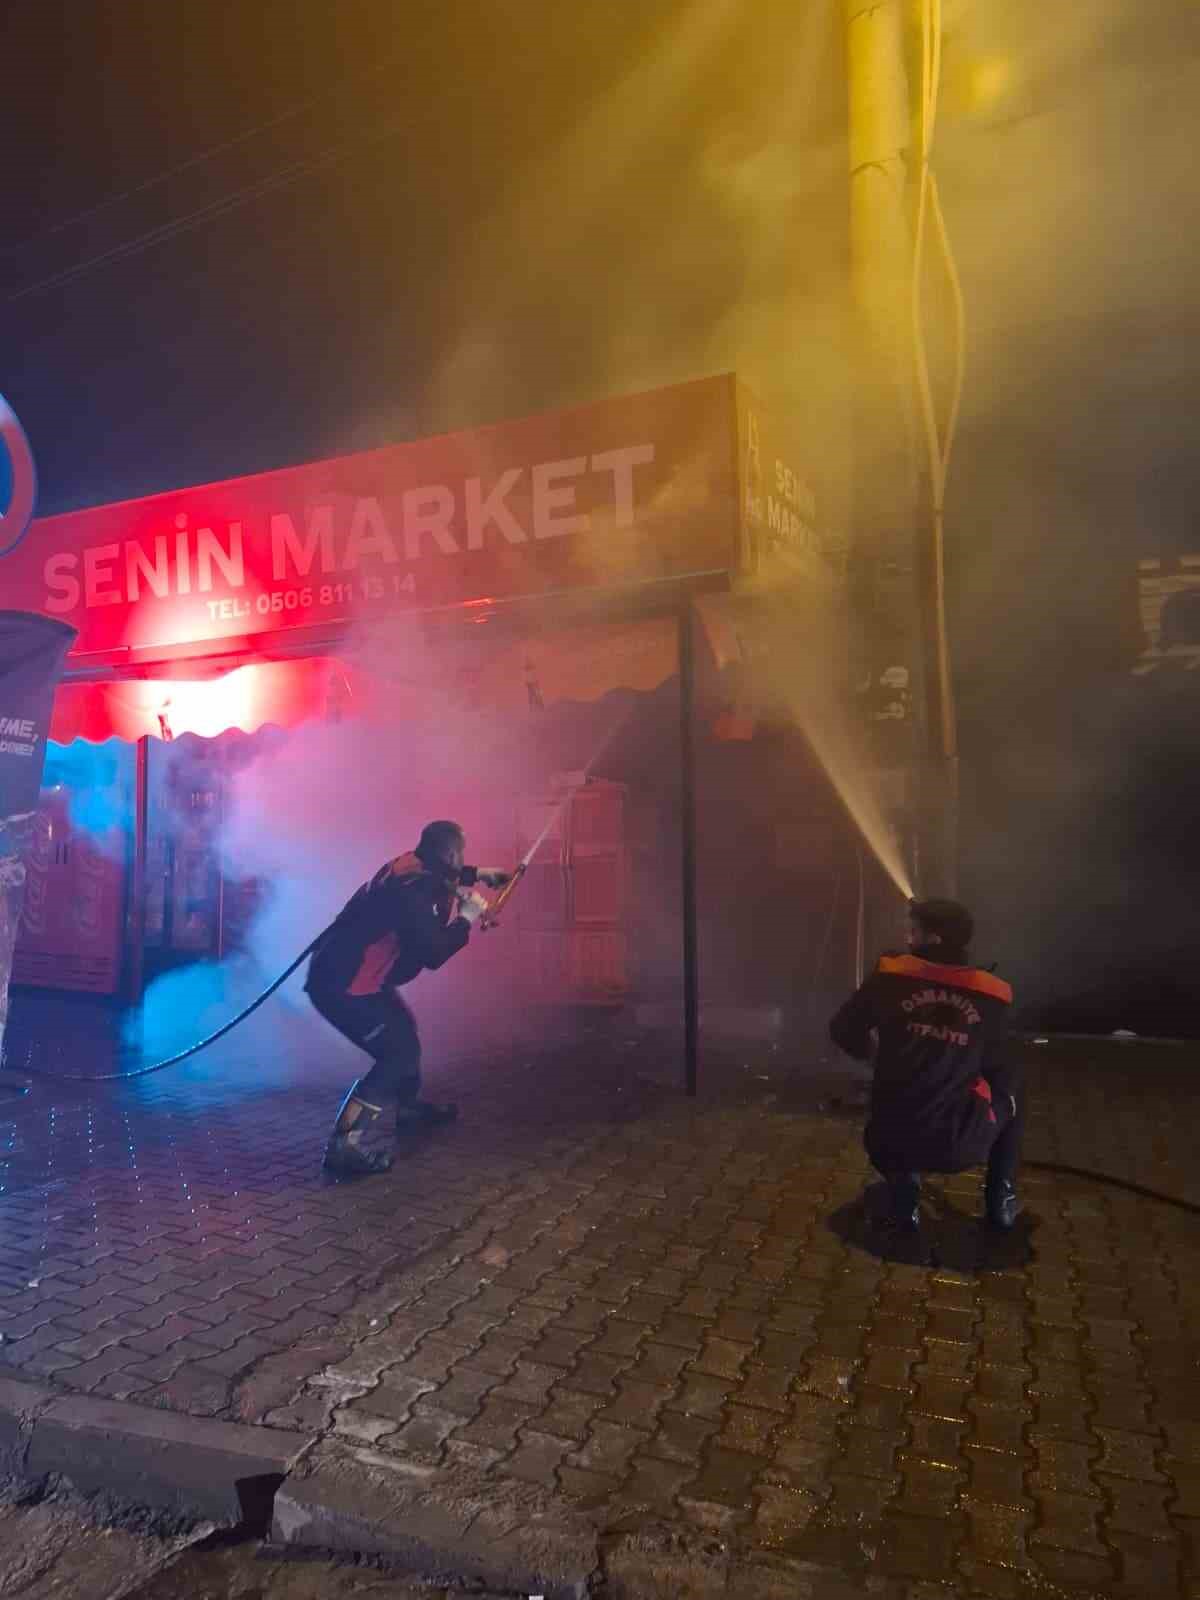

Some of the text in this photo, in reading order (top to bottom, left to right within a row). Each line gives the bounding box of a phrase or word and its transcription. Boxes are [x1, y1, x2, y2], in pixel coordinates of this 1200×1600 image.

[43, 513, 246, 612] SENİN
[271, 443, 655, 582] MARKET
[207, 598, 251, 621] TEL:
[256, 586, 313, 615] 0506
[319, 580, 353, 606] 811
[394, 573, 417, 595] 14
